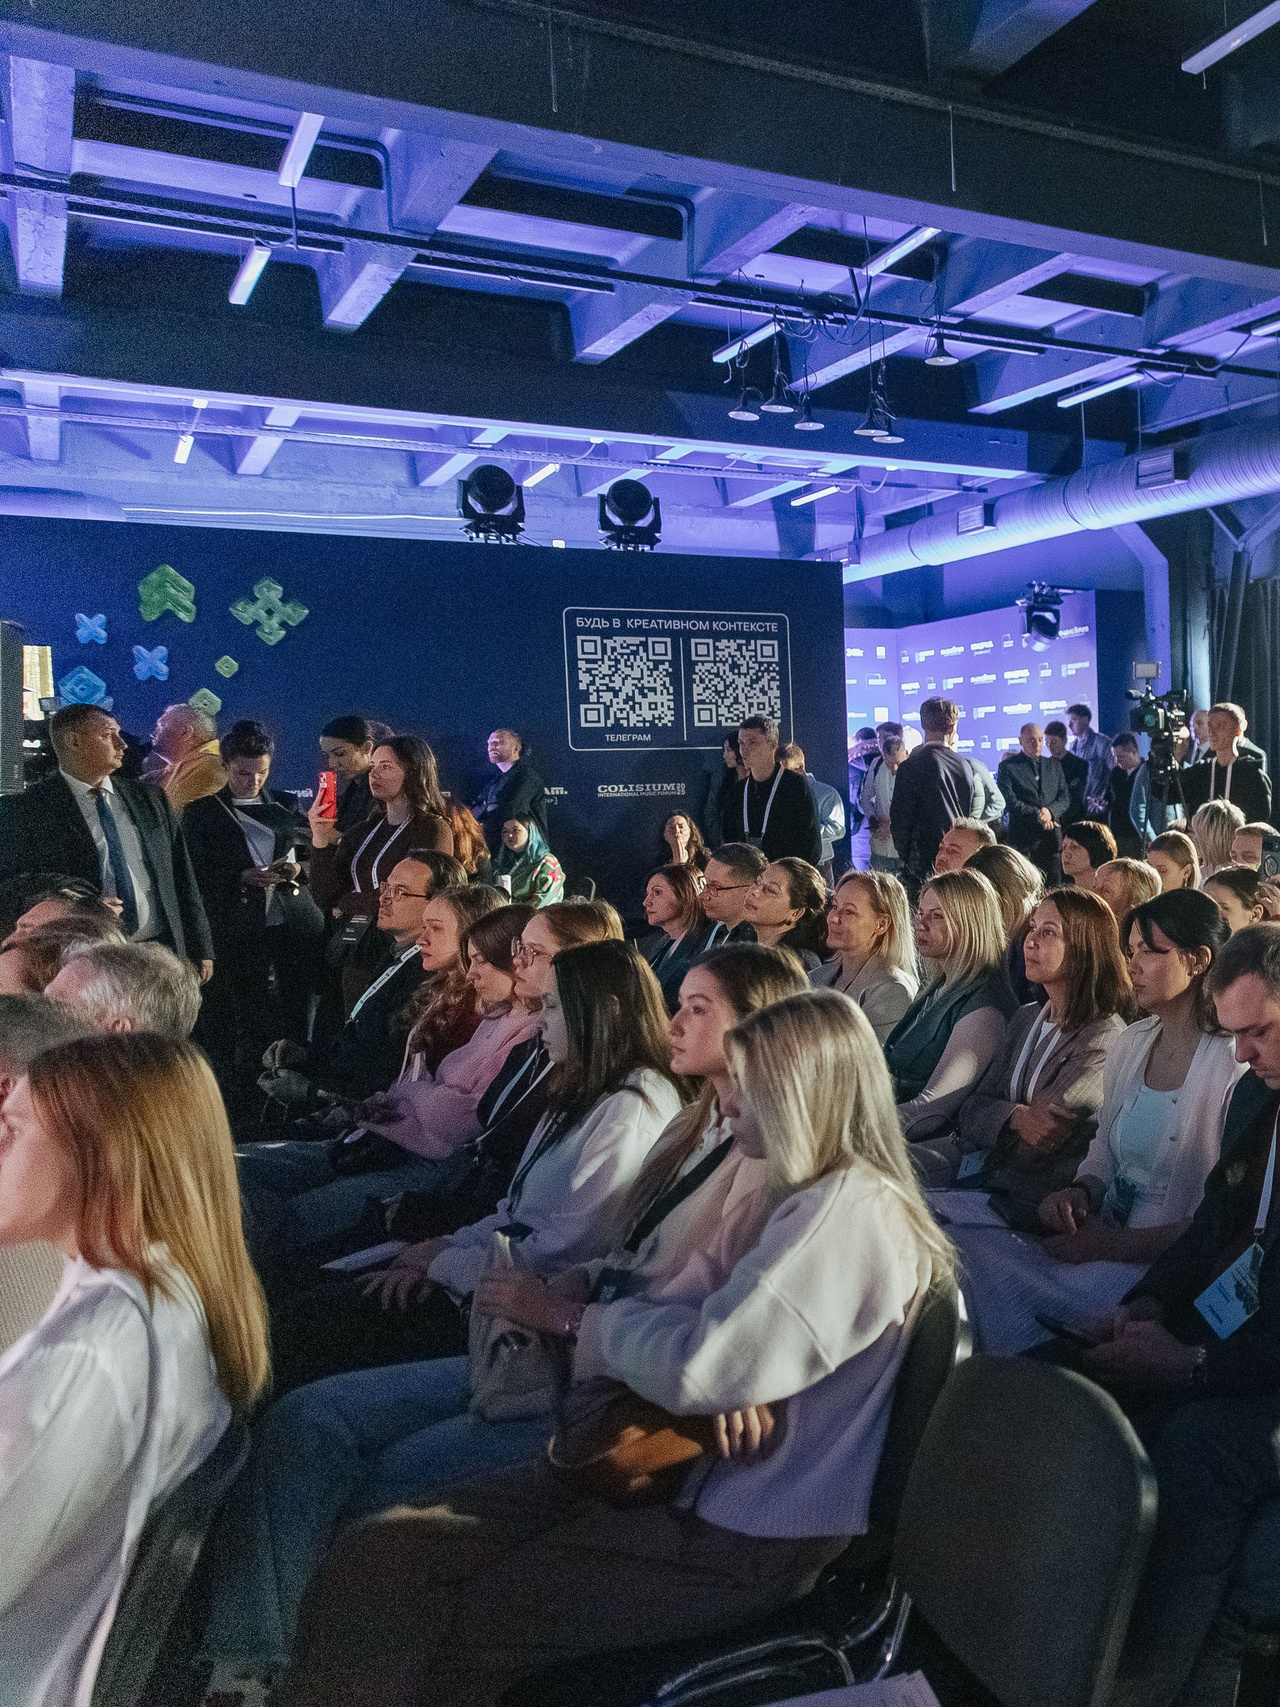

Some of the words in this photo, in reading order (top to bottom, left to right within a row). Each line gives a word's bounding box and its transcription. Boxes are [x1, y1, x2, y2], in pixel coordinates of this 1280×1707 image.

[576, 616, 610, 629] БУДЬ
[612, 617, 621, 628] В
[626, 619, 710, 632] КРЕАТИВНОМ
[712, 621, 779, 633] КОНТЕКСТЕ
[605, 733, 651, 742] ТЕЛЕГРАМ
[598, 784, 676, 793] COLISIUM
